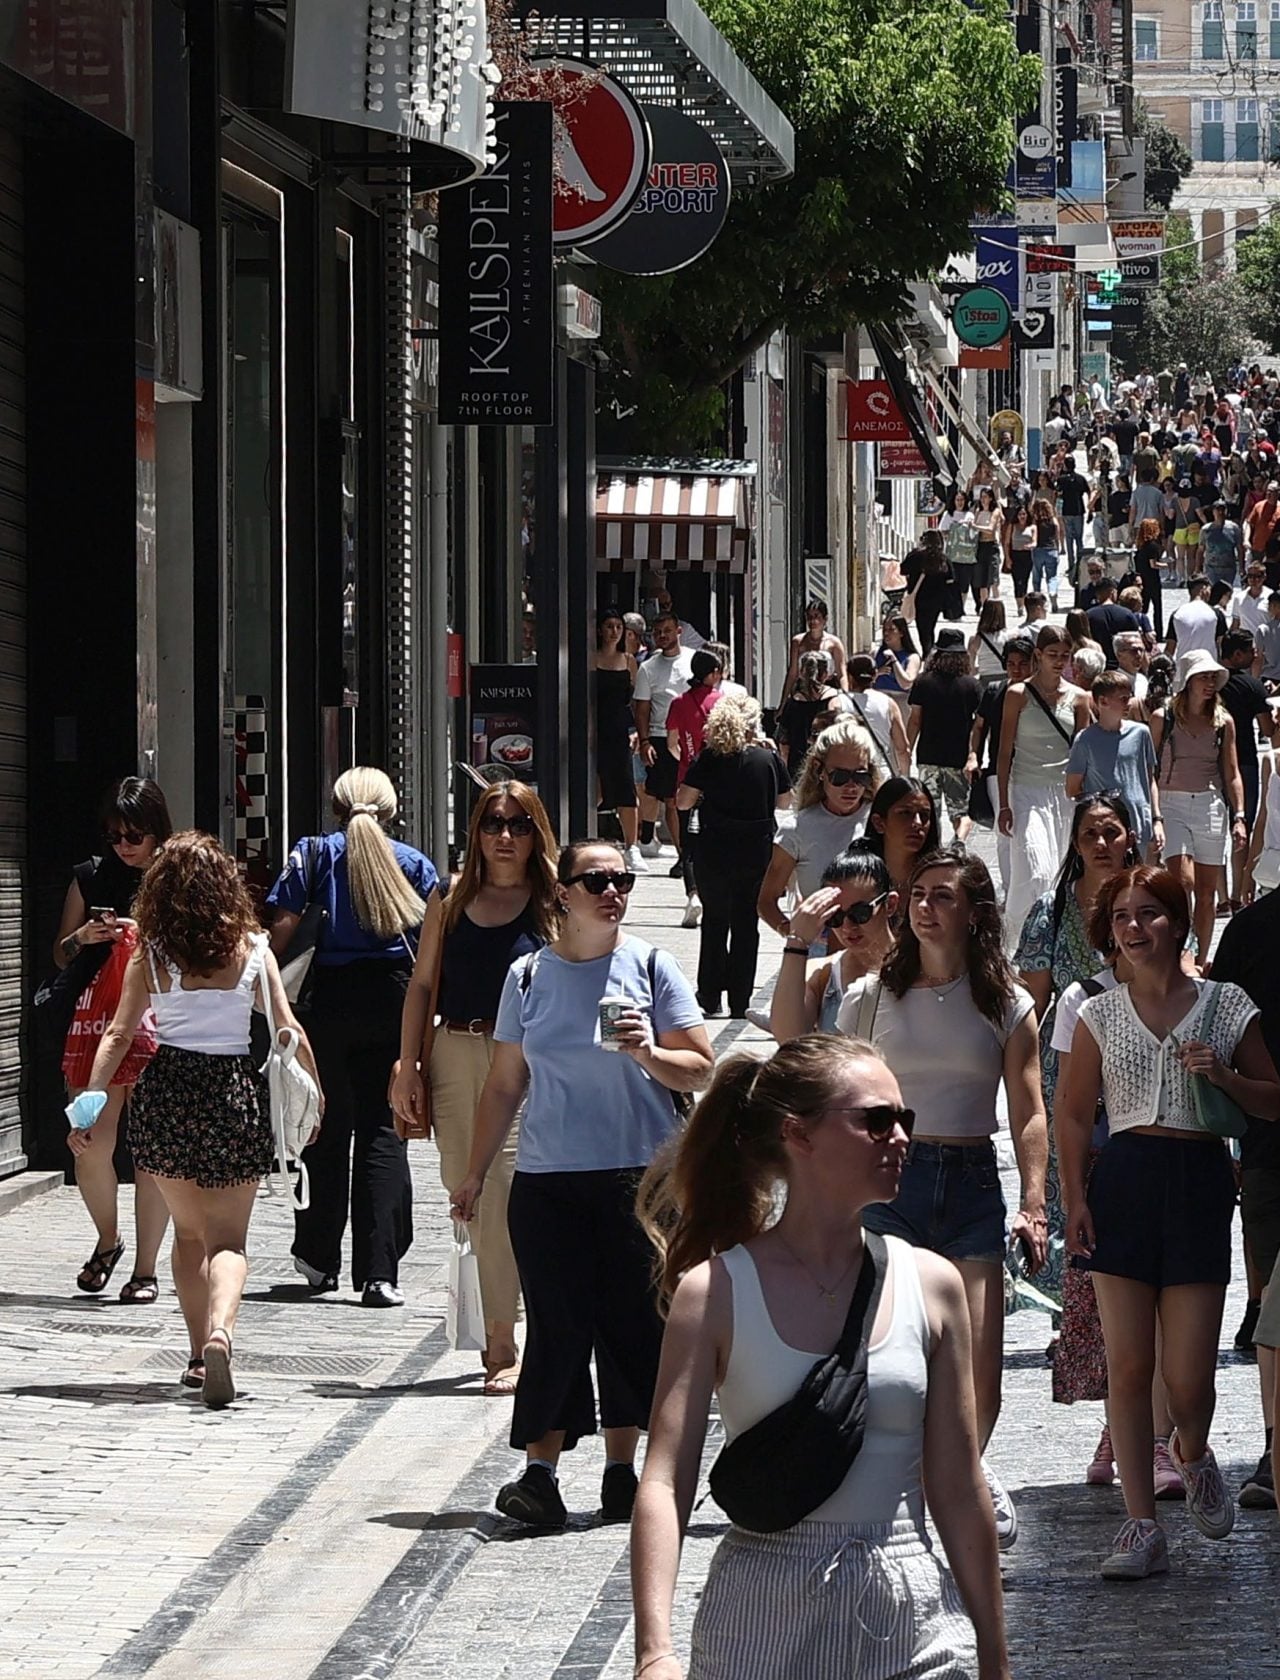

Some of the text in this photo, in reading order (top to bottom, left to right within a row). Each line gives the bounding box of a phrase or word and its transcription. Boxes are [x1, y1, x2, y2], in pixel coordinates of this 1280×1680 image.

[647, 162, 718, 188] NTER
[523, 160, 532, 325] ATHENIAN TAPAS
[1118, 242, 1157, 251] woman
[977, 259, 1014, 280] rex
[461, 392, 530, 402] ROOFTOP
[458, 405, 533, 416] 7th FLOOR
